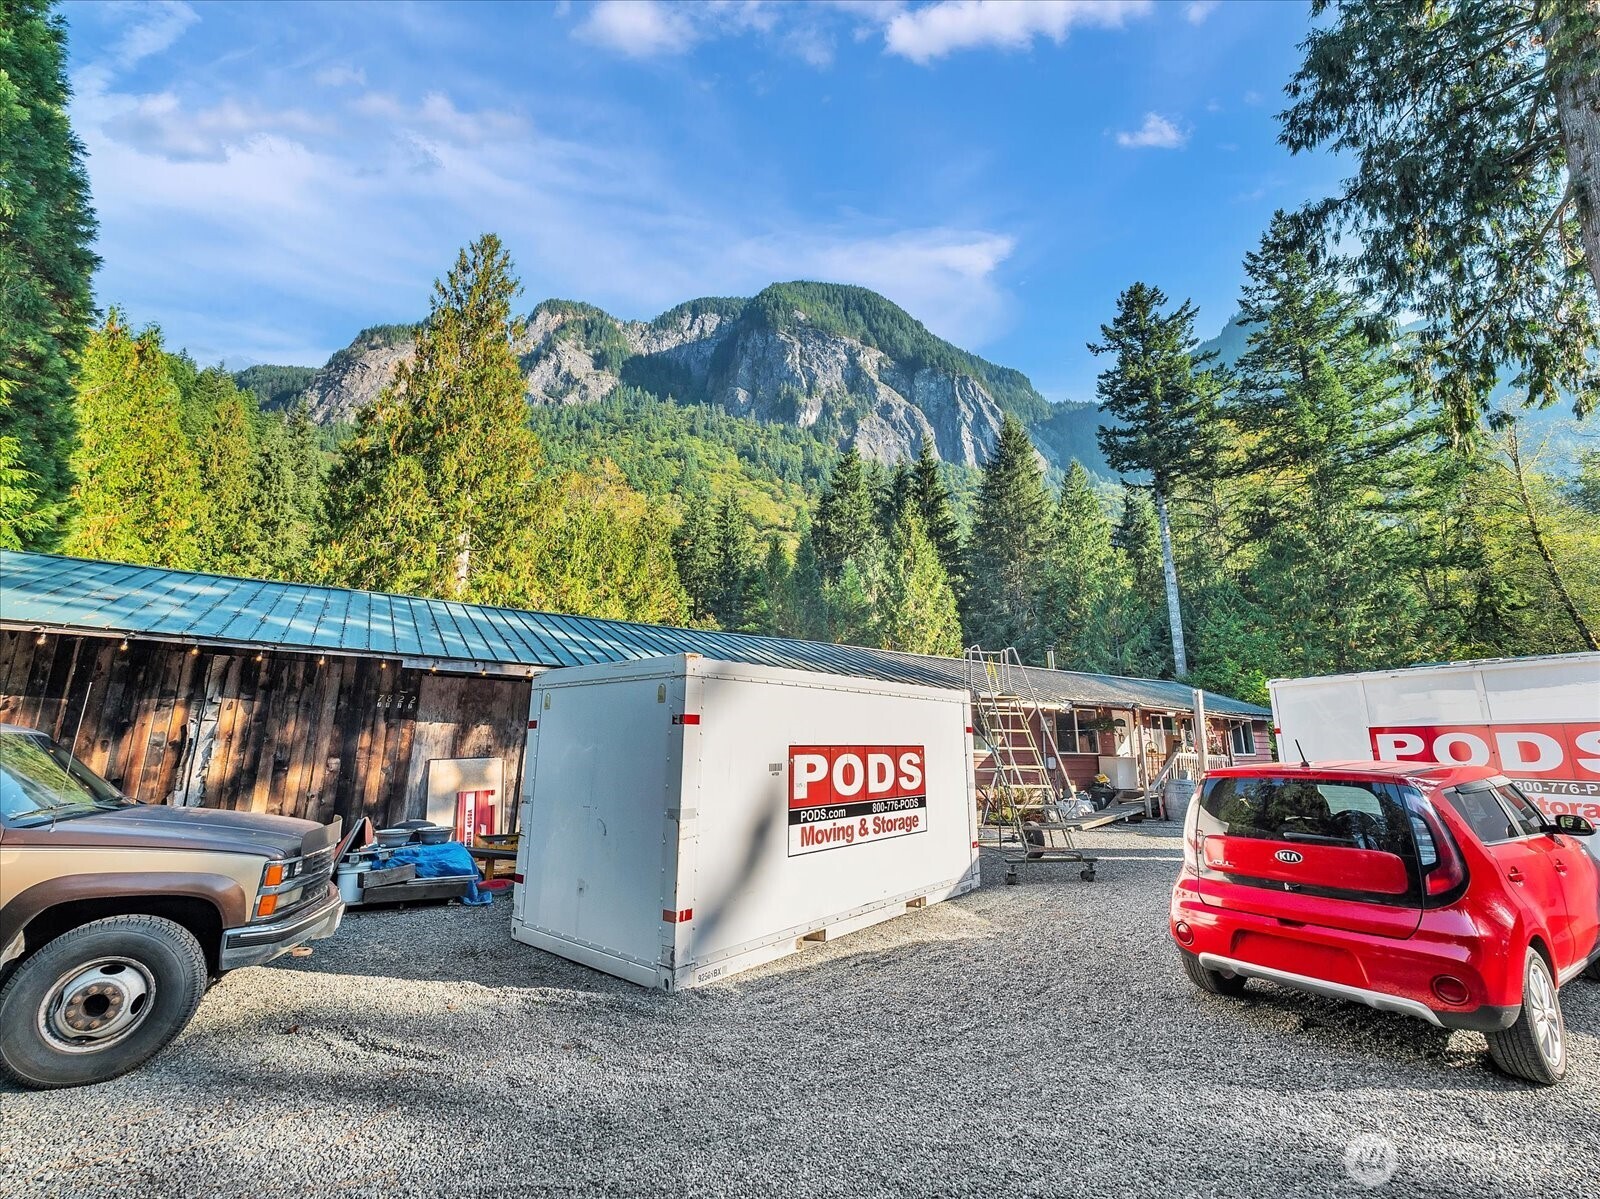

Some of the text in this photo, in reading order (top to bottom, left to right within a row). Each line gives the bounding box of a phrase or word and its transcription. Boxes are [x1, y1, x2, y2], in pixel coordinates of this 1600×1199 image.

[793, 752, 922, 800] PODS
[800, 798, 919, 823] PODS.com 800-776-PODS
[800, 814, 919, 847] Moving & Storage
[1278, 852, 1299, 862] KIA
